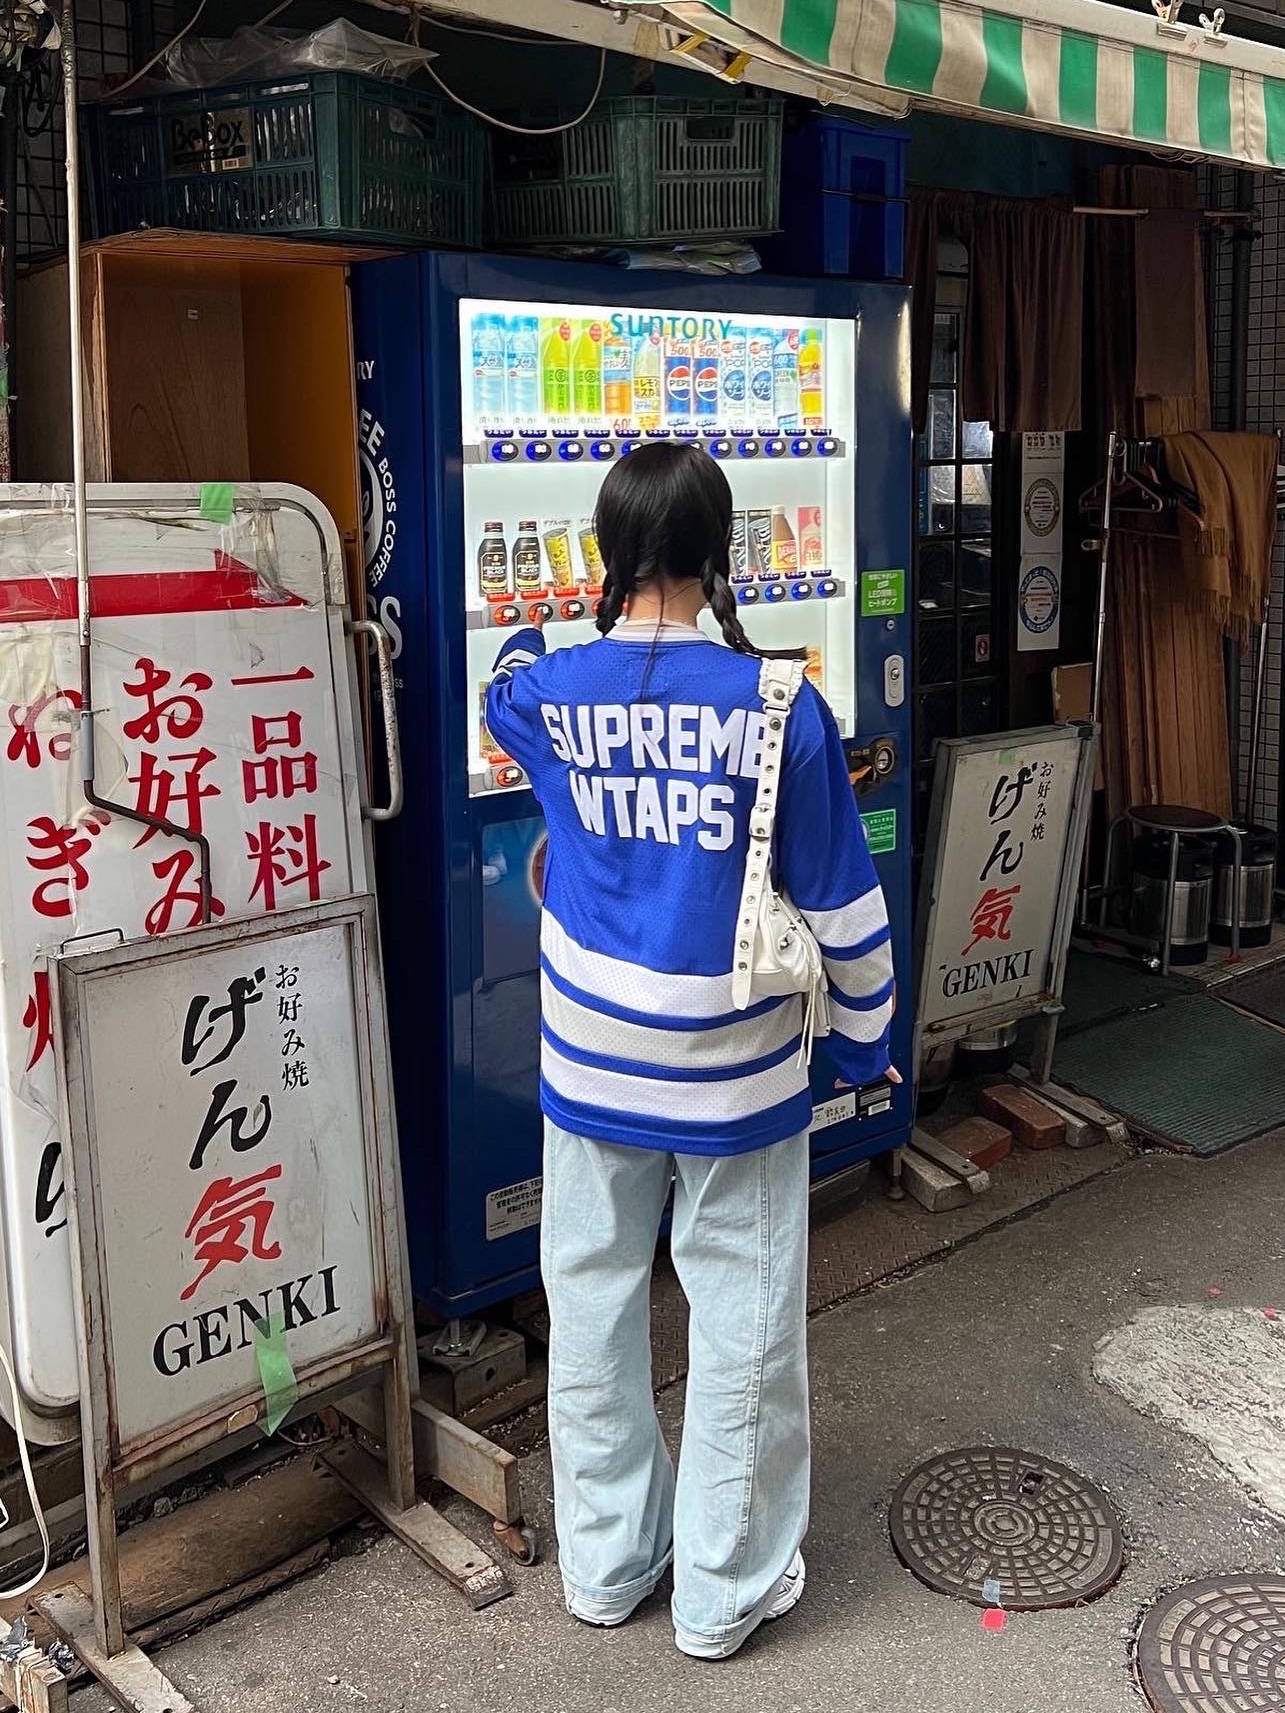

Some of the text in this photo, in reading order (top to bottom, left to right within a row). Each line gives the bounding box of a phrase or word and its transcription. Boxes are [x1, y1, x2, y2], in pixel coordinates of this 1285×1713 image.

[610, 313, 732, 340] SUNTORY
[369, 457, 397, 587] BOSS COFFEE
[123, 658, 225, 935] お好み
[231, 666, 331, 911] 一品料
[540, 703, 766, 779] SUPREME
[1031, 761, 1054, 841] お好み焼
[569, 770, 735, 851] WTAPS
[961, 762, 1038, 957] げん気
[275, 964, 310, 1091] お好み焼
[942, 949, 1035, 998] GENKI
[179, 966, 283, 1301] げん気
[152, 1264, 342, 1377] GENKI
